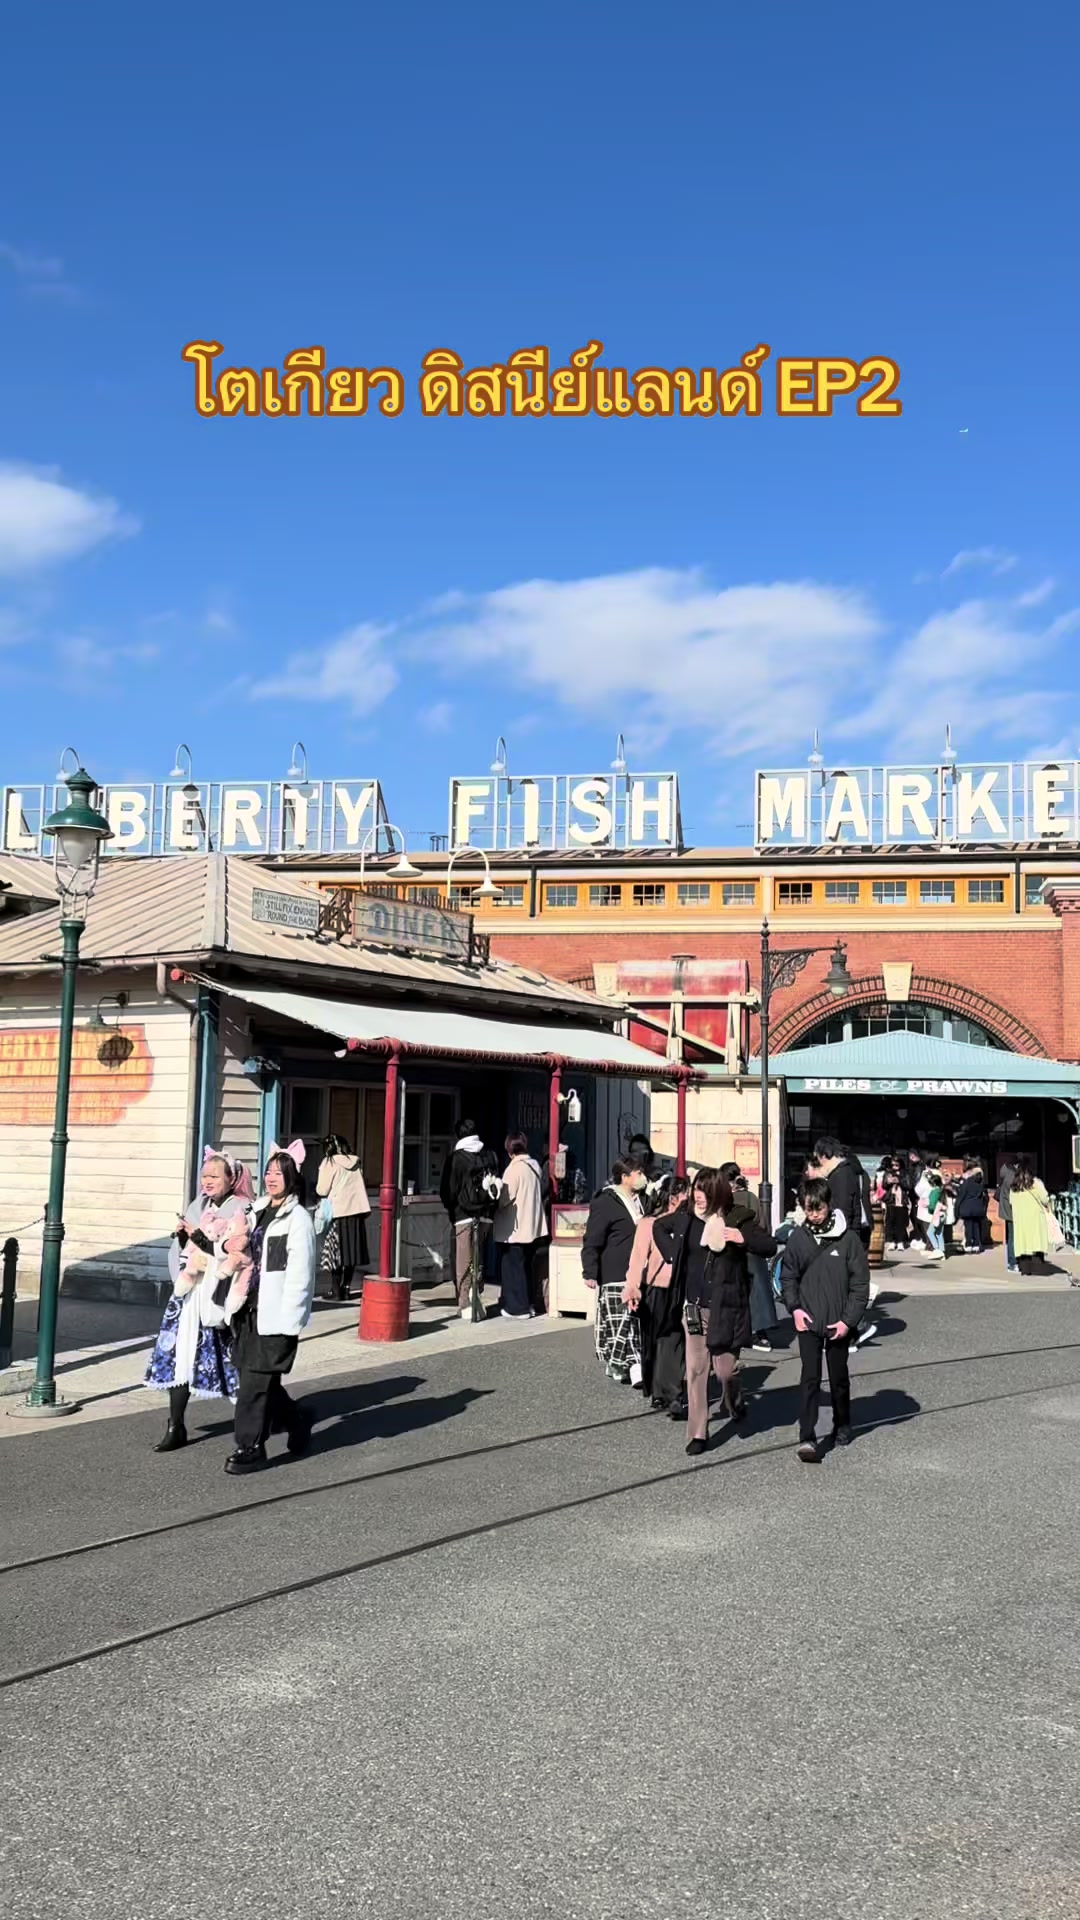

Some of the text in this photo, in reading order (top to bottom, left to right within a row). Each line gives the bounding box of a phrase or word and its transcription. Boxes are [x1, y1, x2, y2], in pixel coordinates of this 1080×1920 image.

[457, 779, 672, 844] FISH
[760, 770, 1070, 839] MARKE
[265, 900, 282, 913] STILL
[366, 903, 457, 950] DINER
[804, 1078, 871, 1091] PILES
[906, 1080, 1007, 1094] PRAWNS
